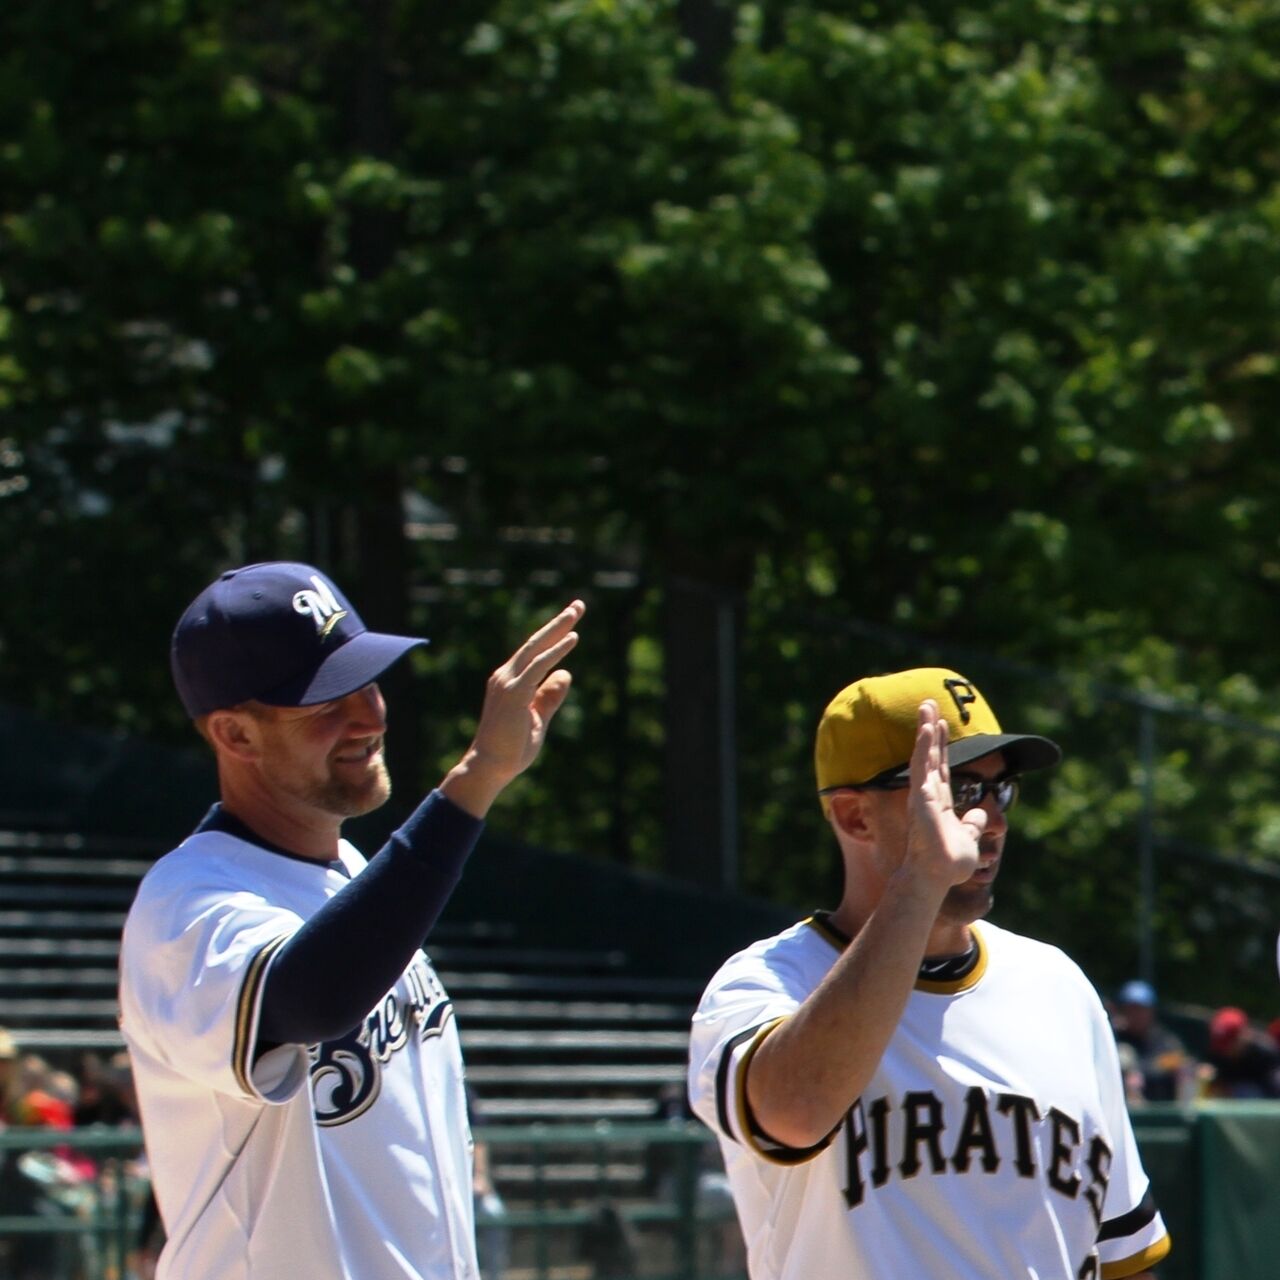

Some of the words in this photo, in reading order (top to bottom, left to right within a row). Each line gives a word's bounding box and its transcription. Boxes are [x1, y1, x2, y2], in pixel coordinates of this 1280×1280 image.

[292, 574, 343, 627] M
[943, 677, 976, 726] P
[842, 1084, 1113, 1234] PIRATES
